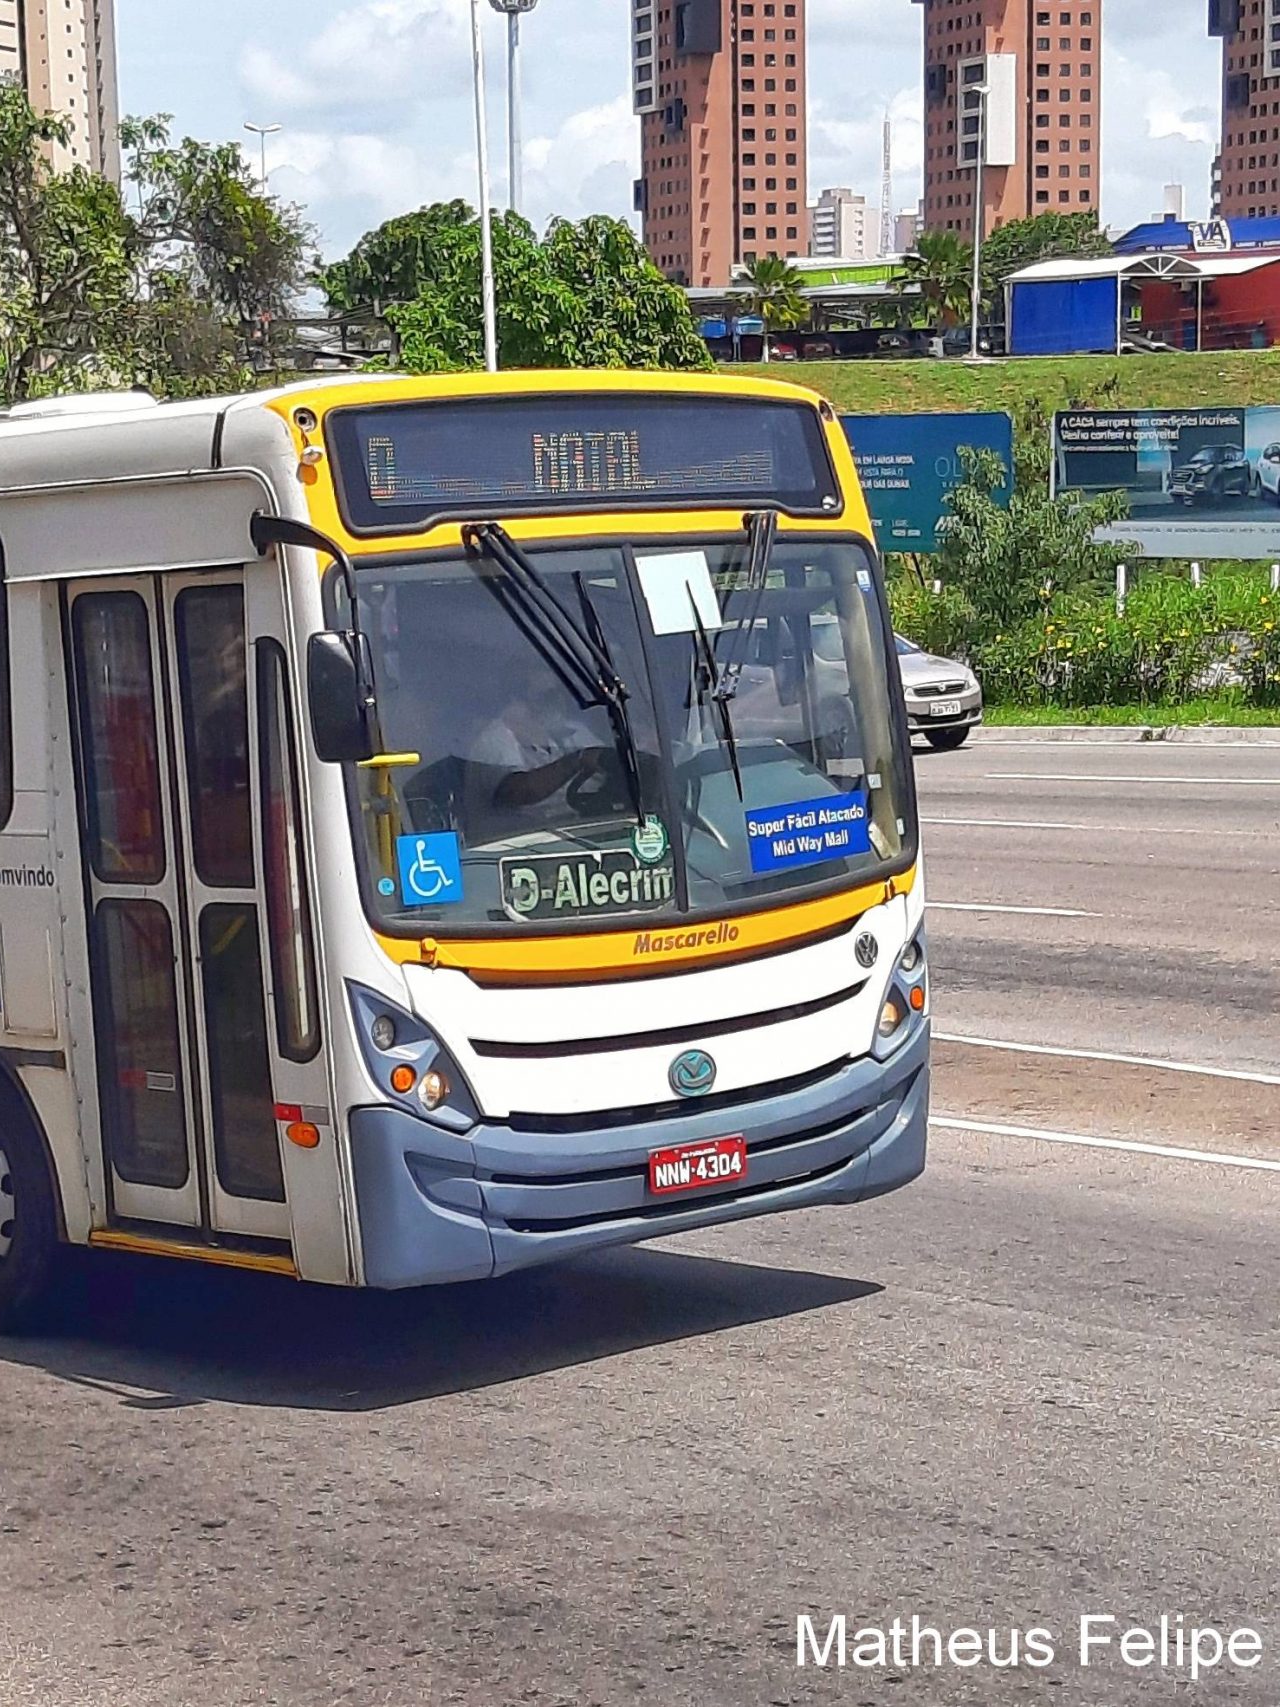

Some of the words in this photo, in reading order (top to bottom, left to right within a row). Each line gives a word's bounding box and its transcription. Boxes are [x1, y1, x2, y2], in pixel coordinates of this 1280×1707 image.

[1096, 418, 1129, 428] sempre
[1131, 417, 1150, 427] tem
[748, 819, 785, 838] Super
[788, 811, 816, 830] Fácil
[819, 804, 864, 825] Atacado
[773, 840, 795, 857] Mid
[798, 836, 823, 853] Way
[825, 829, 849, 847] Mall
[633, 922, 740, 956] Mascarello
